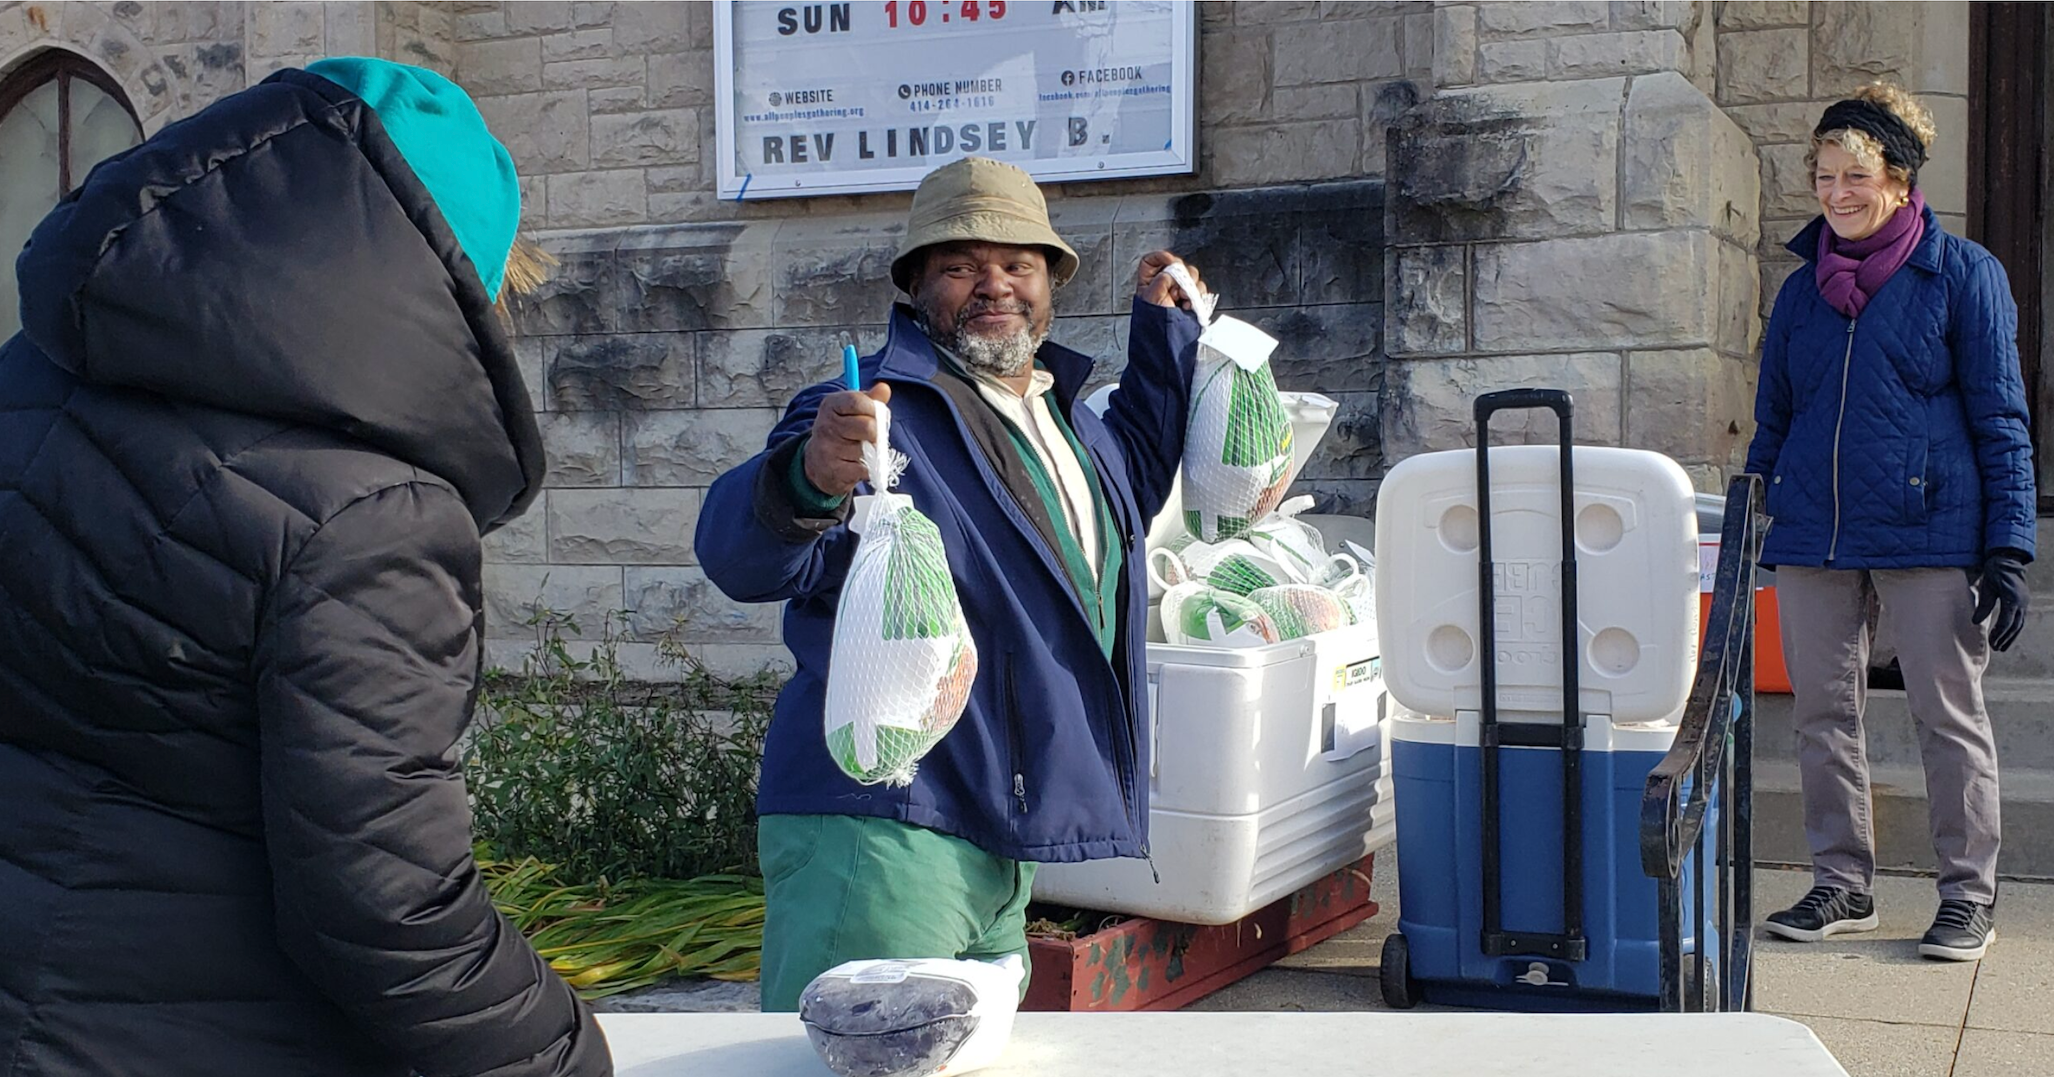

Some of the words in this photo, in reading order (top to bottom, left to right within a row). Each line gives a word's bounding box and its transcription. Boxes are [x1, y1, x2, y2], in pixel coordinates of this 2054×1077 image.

[777, 3, 850, 36] SUN
[1078, 66, 1142, 84] FACEBOOK
[785, 89, 833, 105] WEBSITE
[914, 82, 950, 97] PHONE
[955, 78, 1002, 94] NUMBER
[763, 133, 835, 164] REV
[859, 121, 1036, 159] LINDSEY
